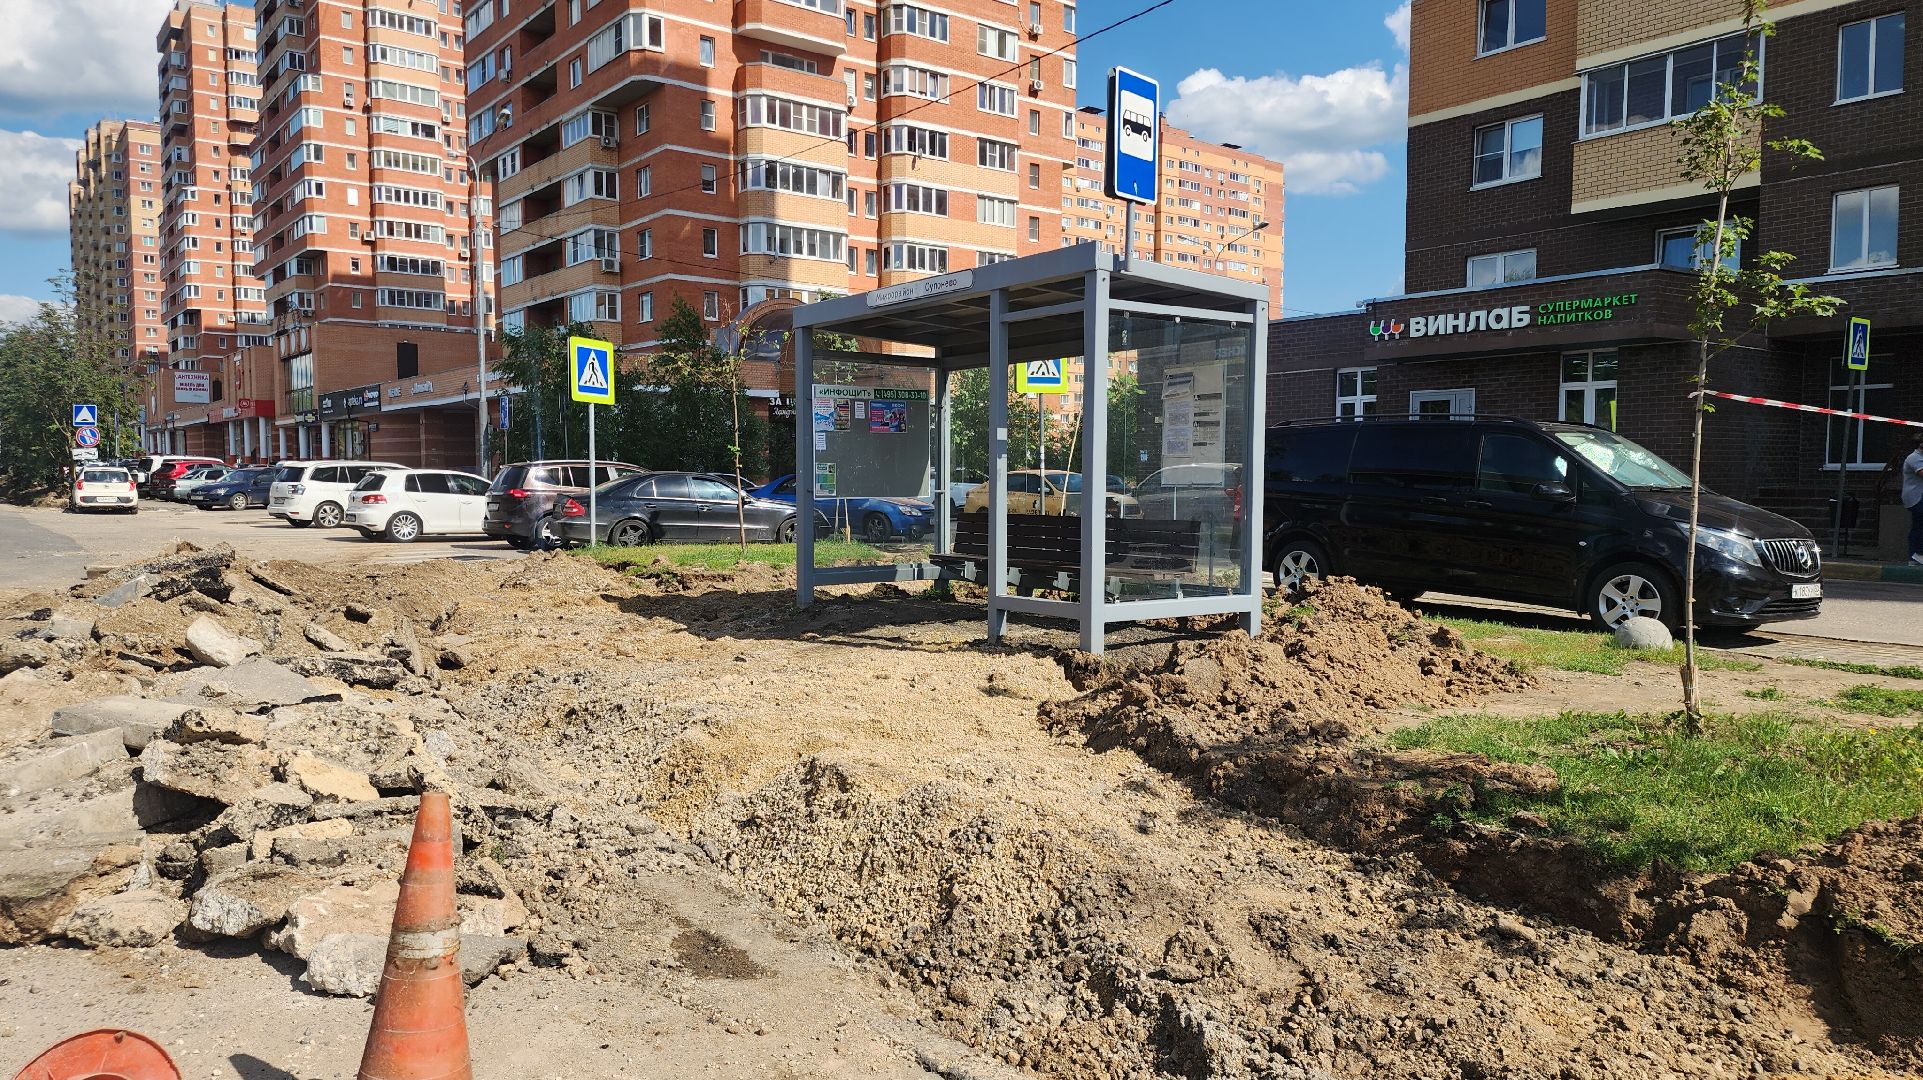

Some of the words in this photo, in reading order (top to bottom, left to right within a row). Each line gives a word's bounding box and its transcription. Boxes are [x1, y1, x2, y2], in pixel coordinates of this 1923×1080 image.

[925, 279, 957, 293] Супонево
[1538, 294, 1638, 314] СУПЕРМАРКЕТ
[1538, 309, 1613, 326] НАПИТКОВ
[819, 388, 872, 397] «ИНФОЩИТ»
